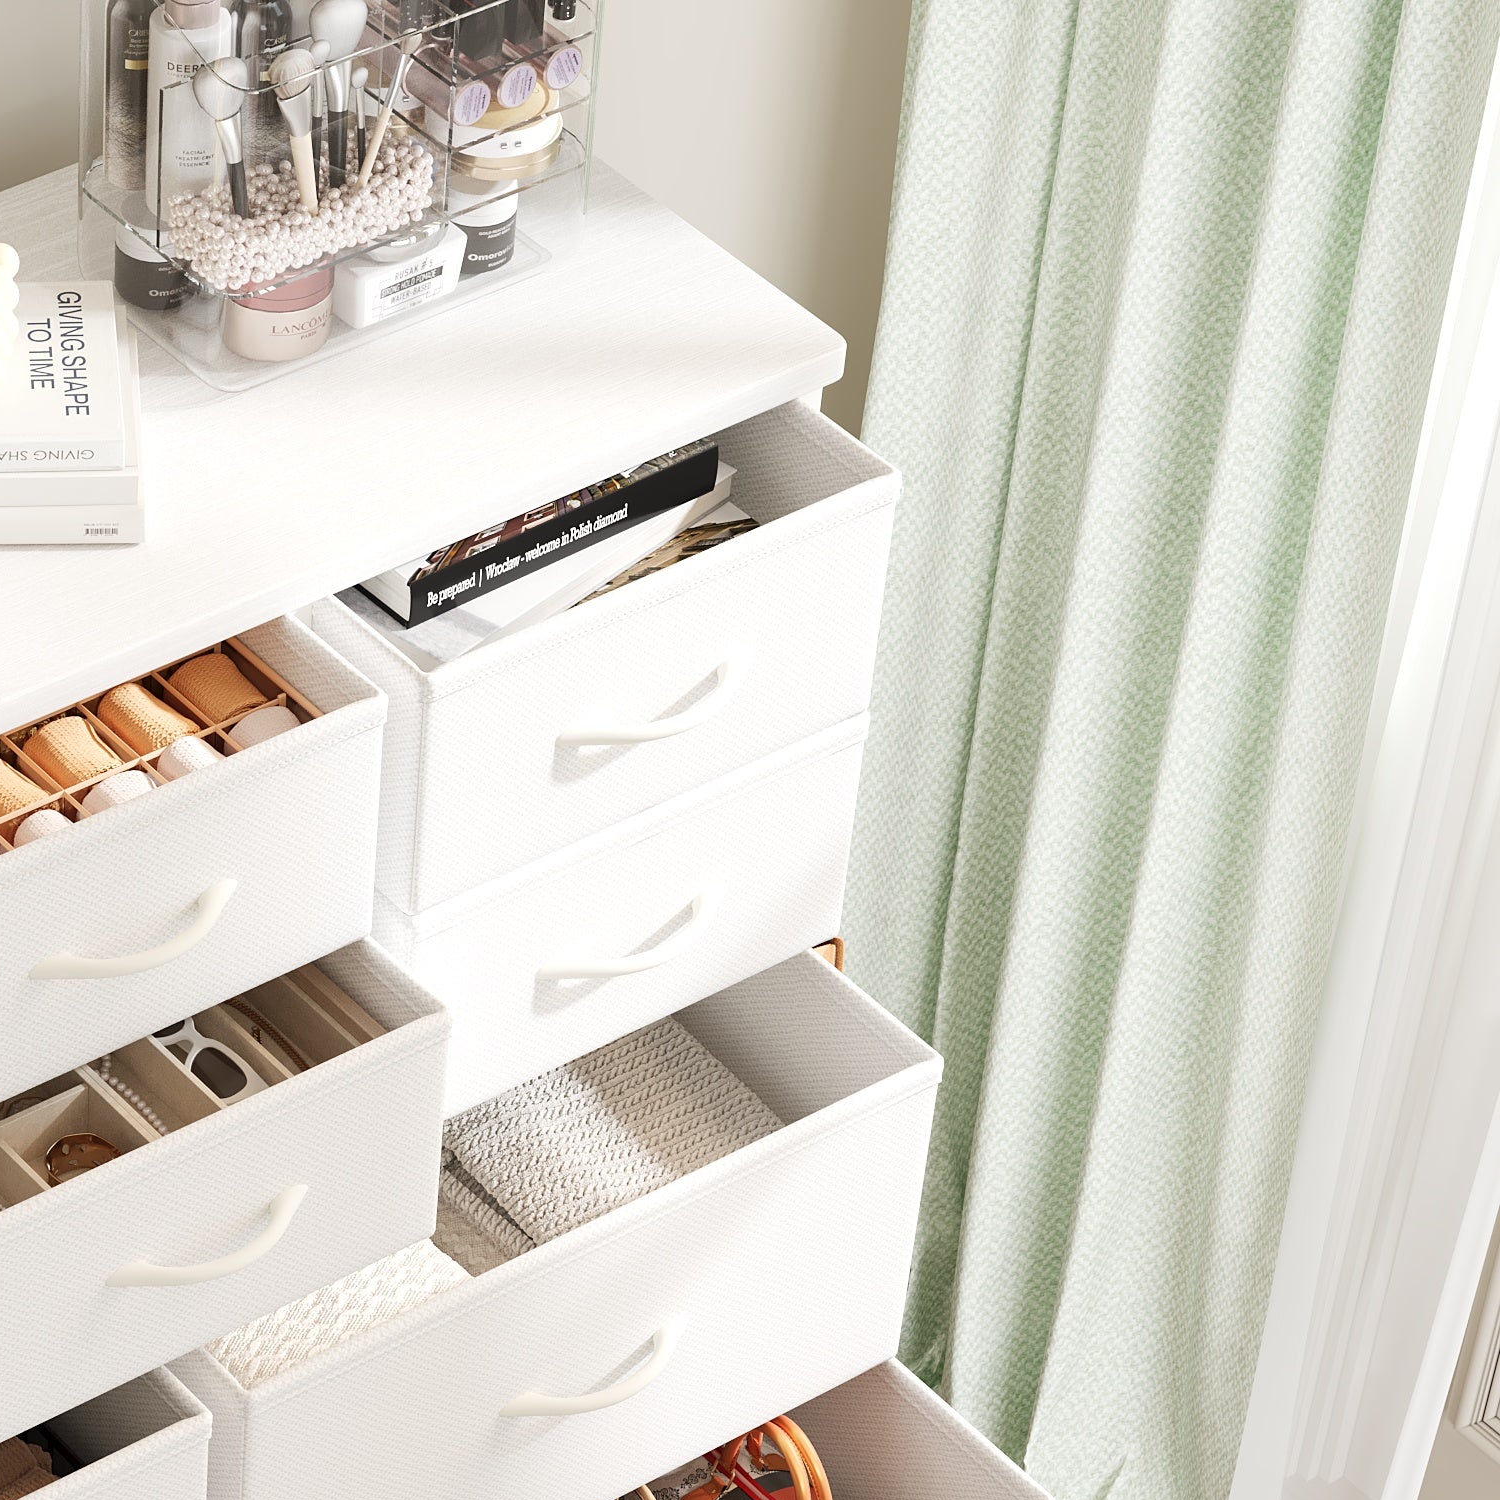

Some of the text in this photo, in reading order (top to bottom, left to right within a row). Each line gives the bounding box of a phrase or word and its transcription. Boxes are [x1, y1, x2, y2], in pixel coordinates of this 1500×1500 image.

[27, 318, 55, 390] TO TIME
[56, 291, 90, 416] GIVING SHAPE
[33, 449, 95, 461] GIVING
[426, 591, 439, 607] Be
[438, 571, 476, 605] prepared
[524, 537, 561, 563] welcome
[560, 531, 570, 546] in
[569, 521, 594, 543] Polish
[593, 503, 629, 532] diamond
